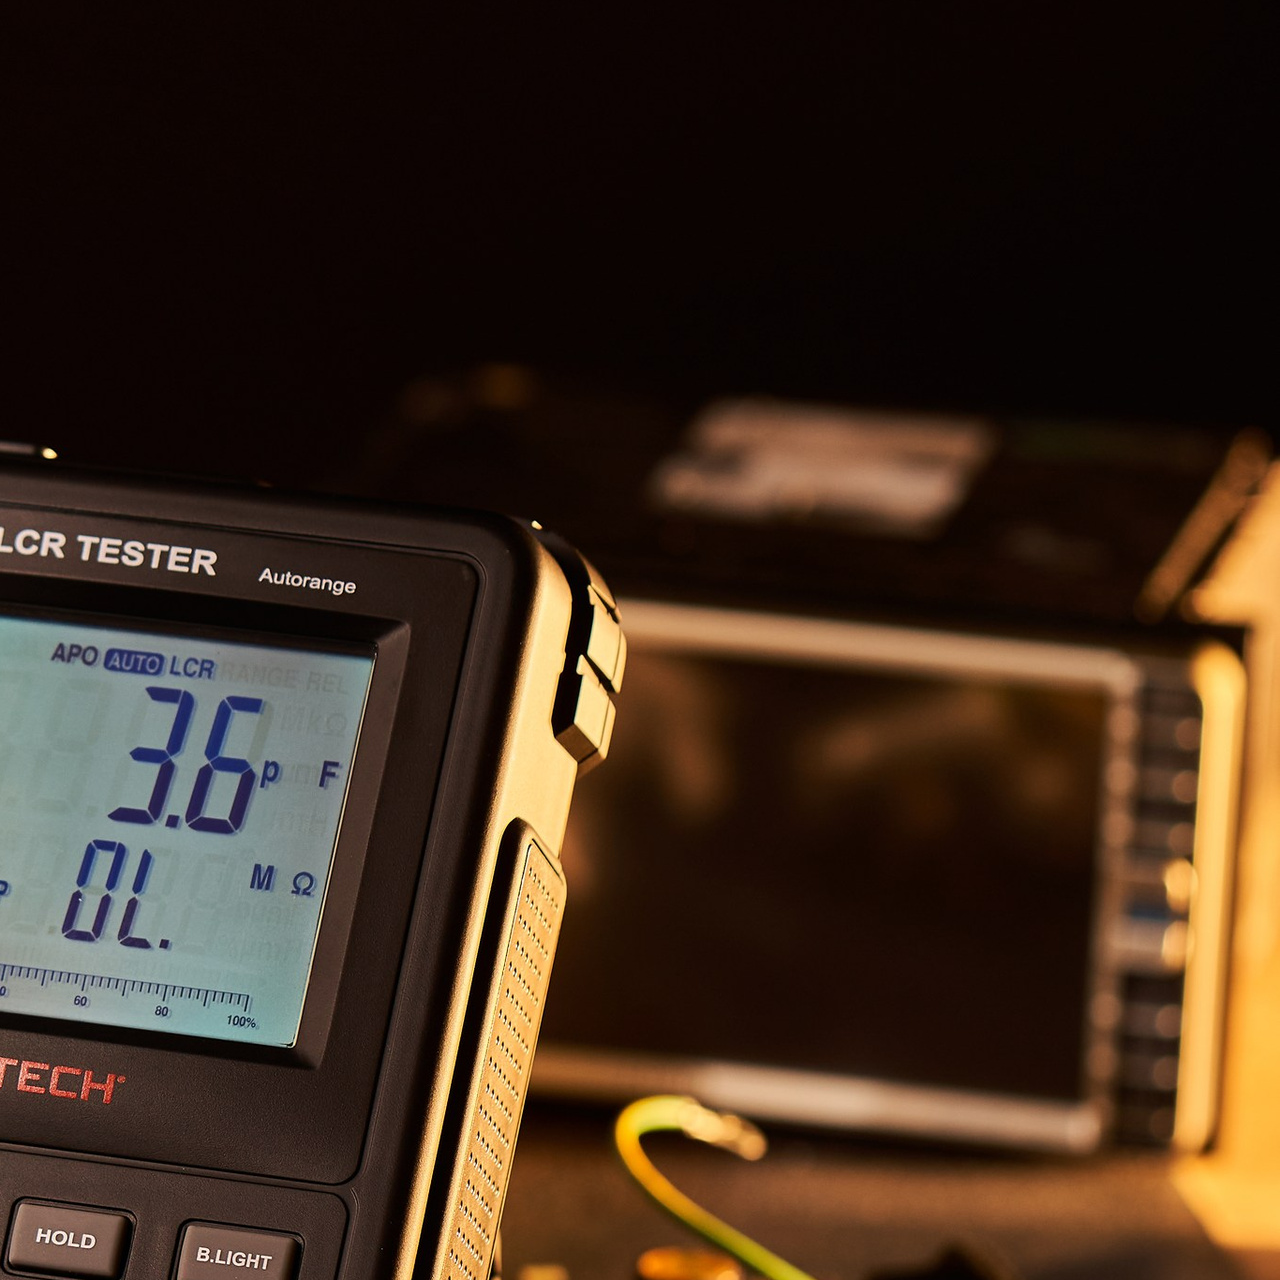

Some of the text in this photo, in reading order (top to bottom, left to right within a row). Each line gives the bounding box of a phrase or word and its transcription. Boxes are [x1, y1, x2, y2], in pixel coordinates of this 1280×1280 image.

[76, 534, 218, 577] TESTER
[258, 567, 357, 596] Autorange
[50, 643, 98, 666] APO
[106, 651, 161, 673] AUTO
[169, 656, 215, 679] LCR
[107, 686, 264, 835] 3.6
[319, 760, 340, 788] F
[249, 863, 275, 892] M
[73, 995, 88, 1007] 60
[154, 1005, 170, 1018] 80
[226, 1015, 258, 1029] 100%
[35, 1227, 97, 1250] HOLD
[195, 1247, 273, 1270] B.LIGHT
